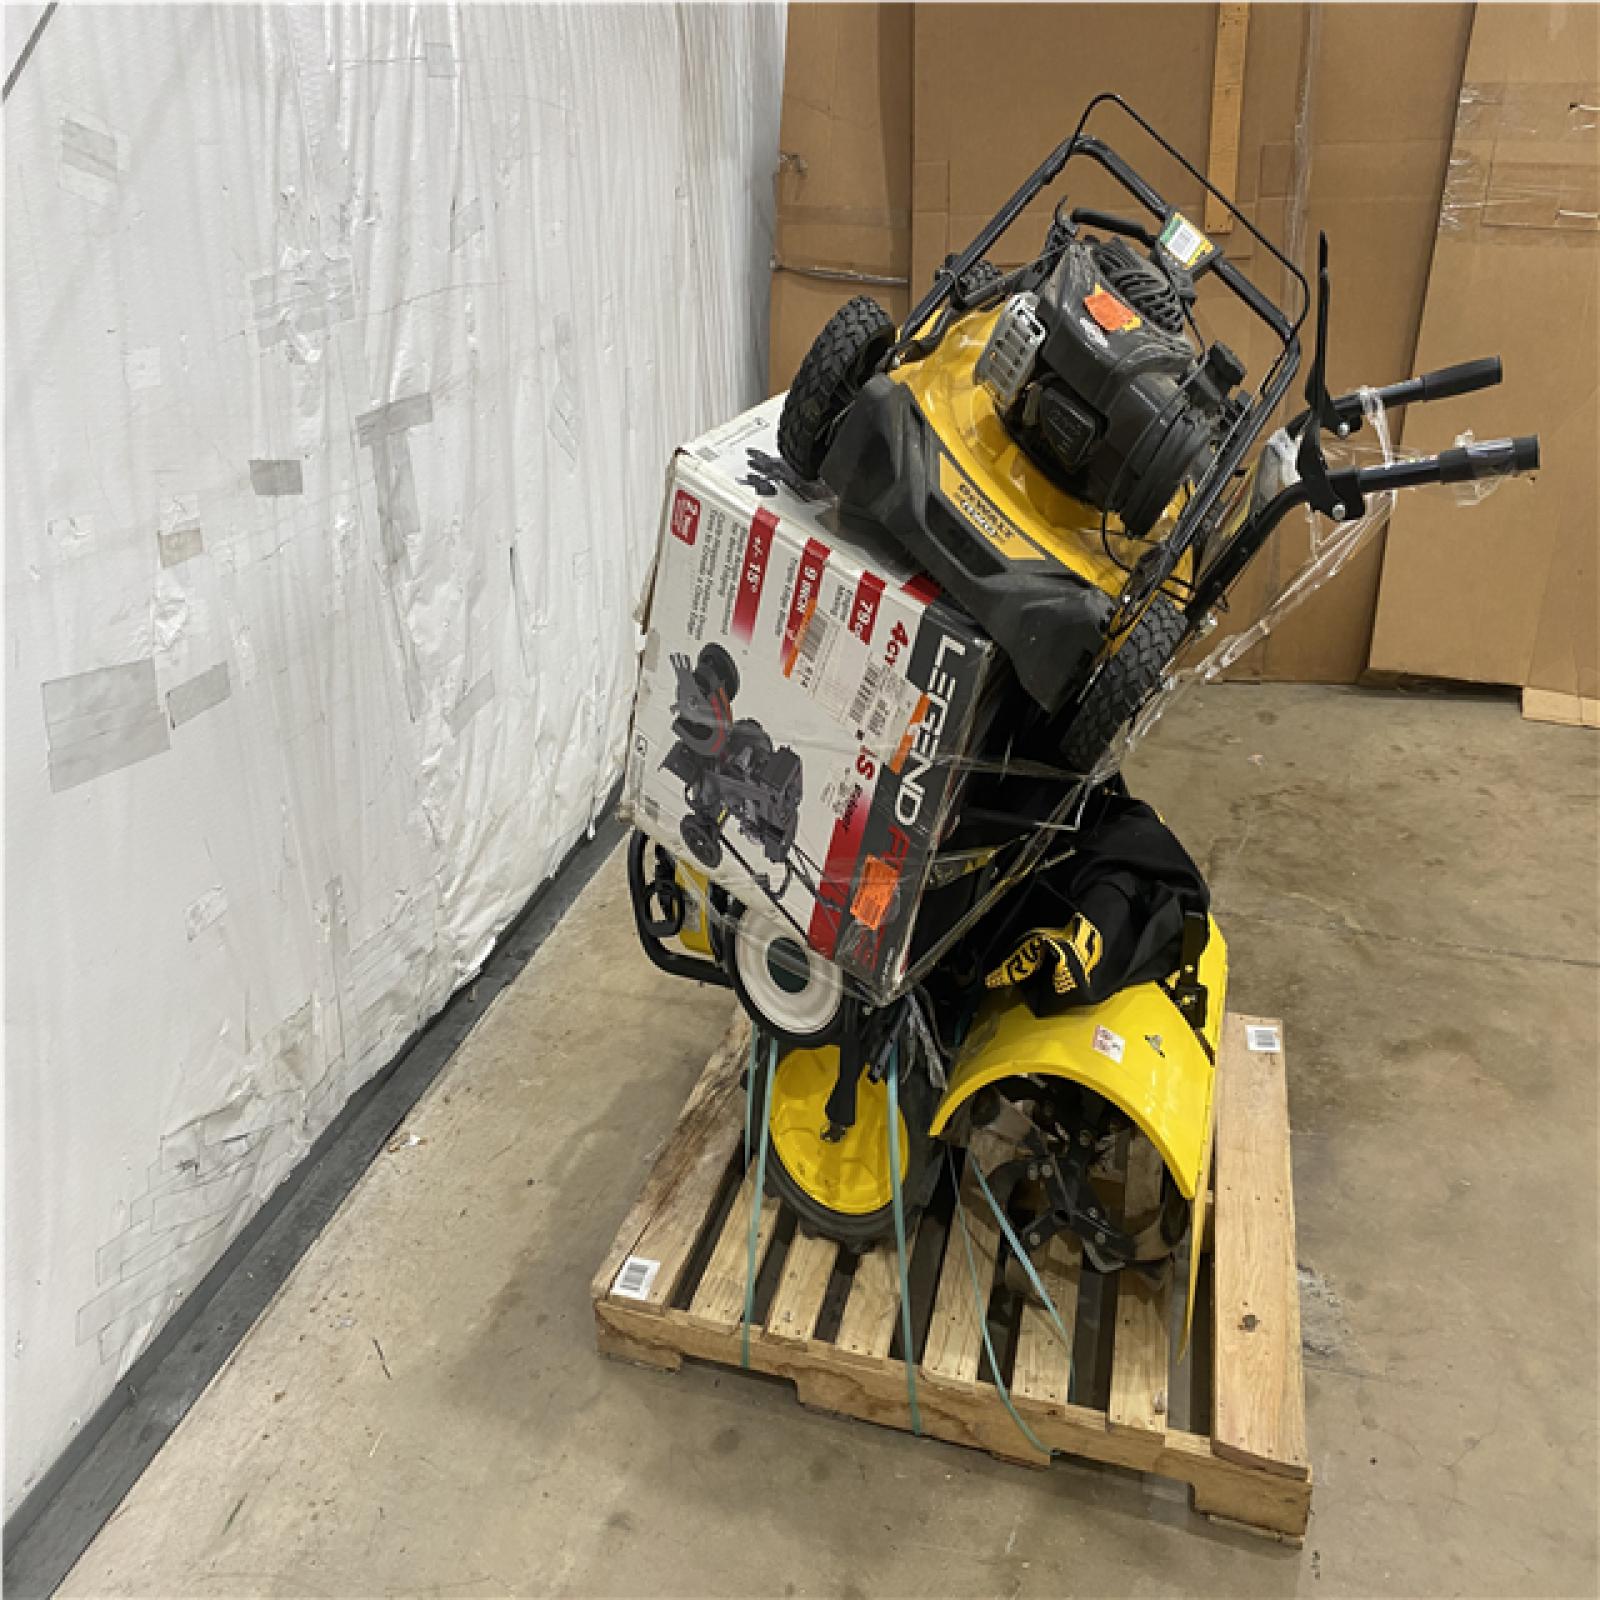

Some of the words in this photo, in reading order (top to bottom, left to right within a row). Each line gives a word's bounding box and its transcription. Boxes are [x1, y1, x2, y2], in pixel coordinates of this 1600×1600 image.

[802, 565, 816, 581] 9
[796, 580, 811, 613] INCH
[894, 635, 965, 826] LEGEND
